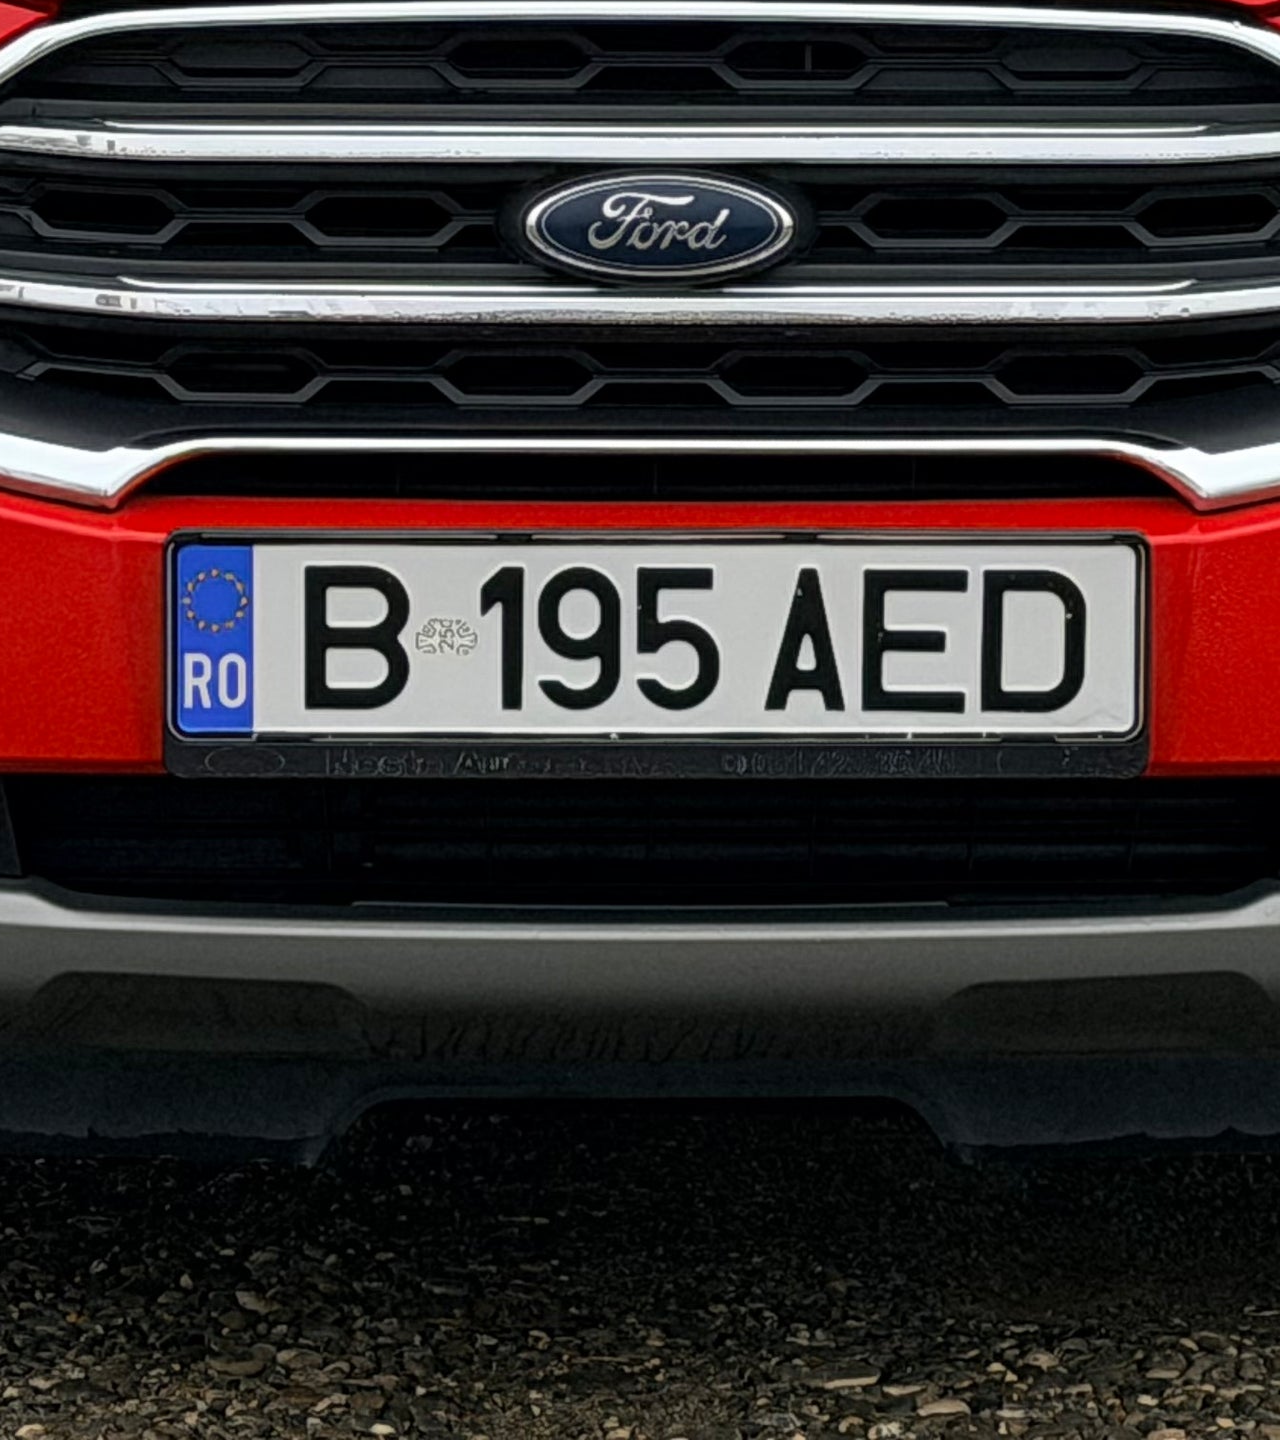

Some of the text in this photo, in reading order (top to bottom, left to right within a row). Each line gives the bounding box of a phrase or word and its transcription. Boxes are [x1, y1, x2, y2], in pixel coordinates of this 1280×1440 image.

[587, 191, 730, 250] Ford
[305, 565, 1087, 713] B 195 AED
[183, 653, 247, 709] RO
